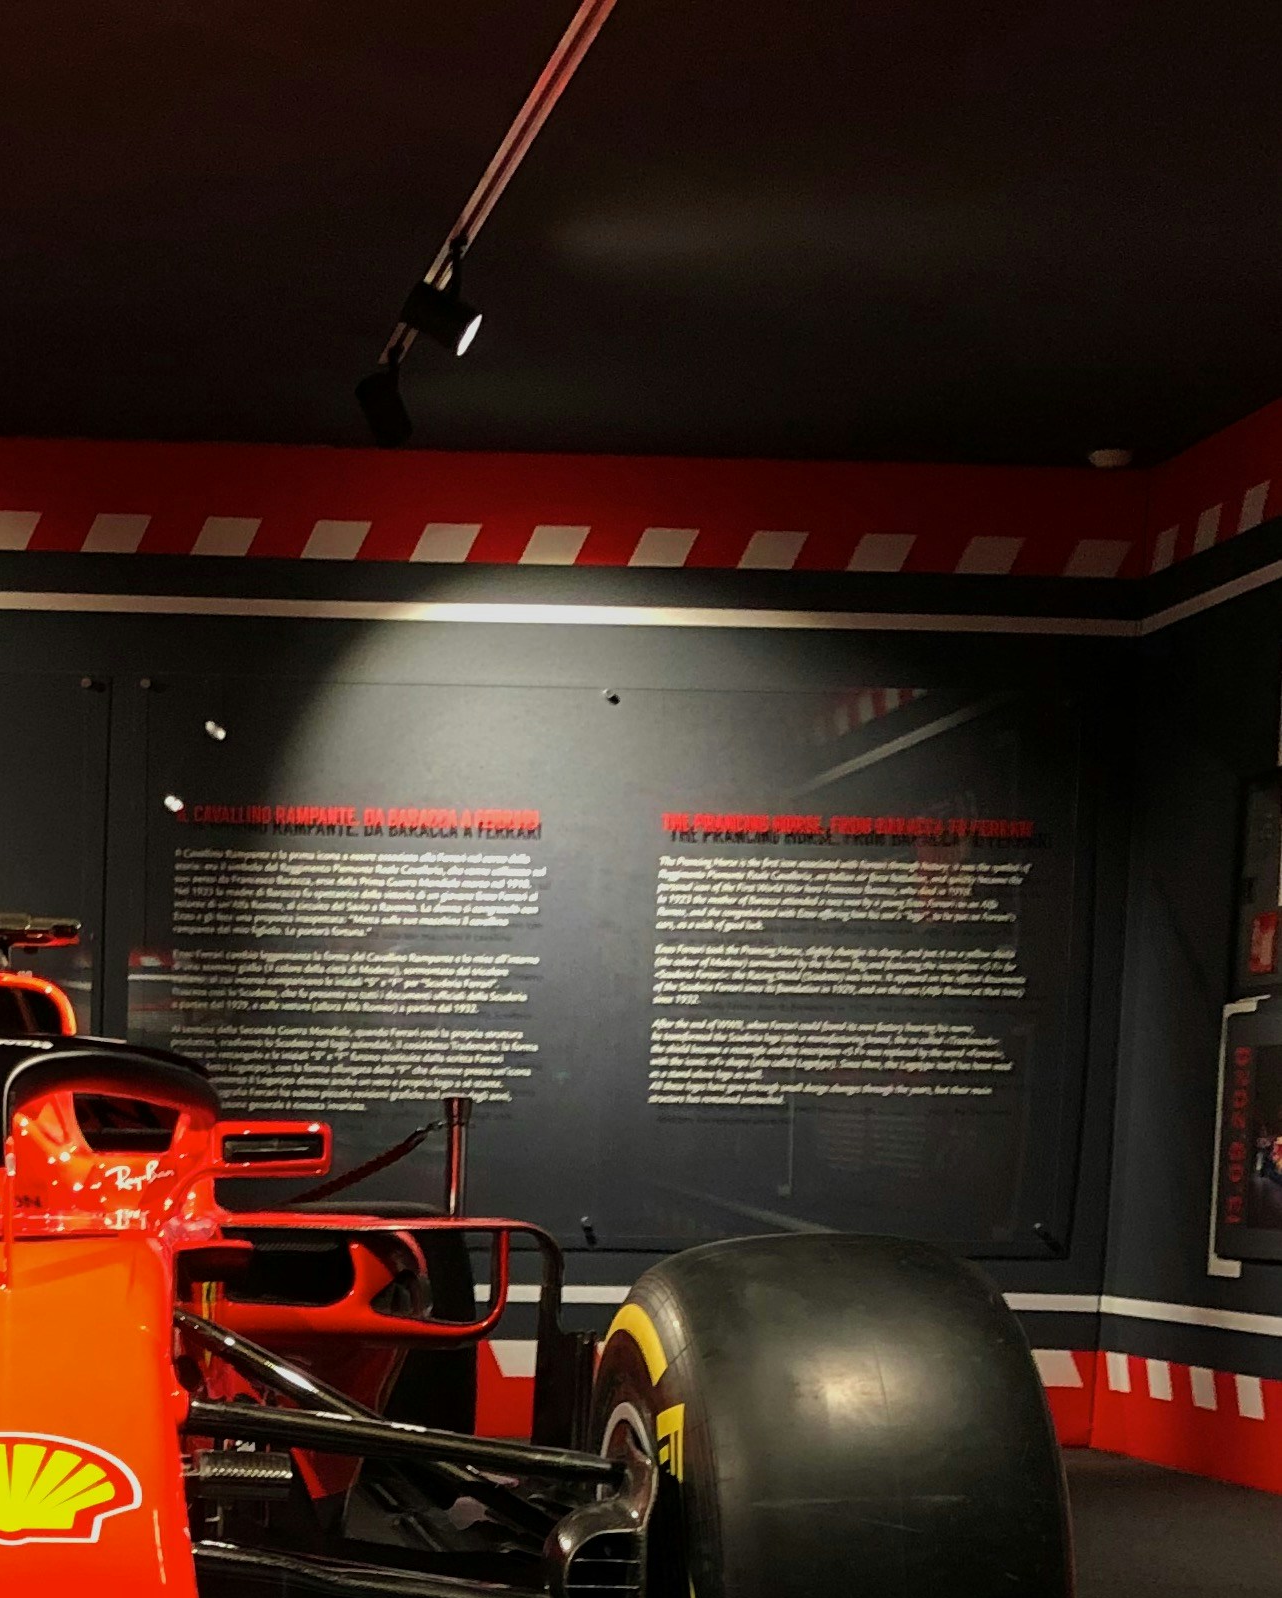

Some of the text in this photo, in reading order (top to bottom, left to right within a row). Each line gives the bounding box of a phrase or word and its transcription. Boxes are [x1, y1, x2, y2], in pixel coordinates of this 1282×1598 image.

[194, 805, 271, 824] CAVALLINO
[363, 808, 385, 828] DA
[104, 1160, 175, 1191] Ray-Ban
